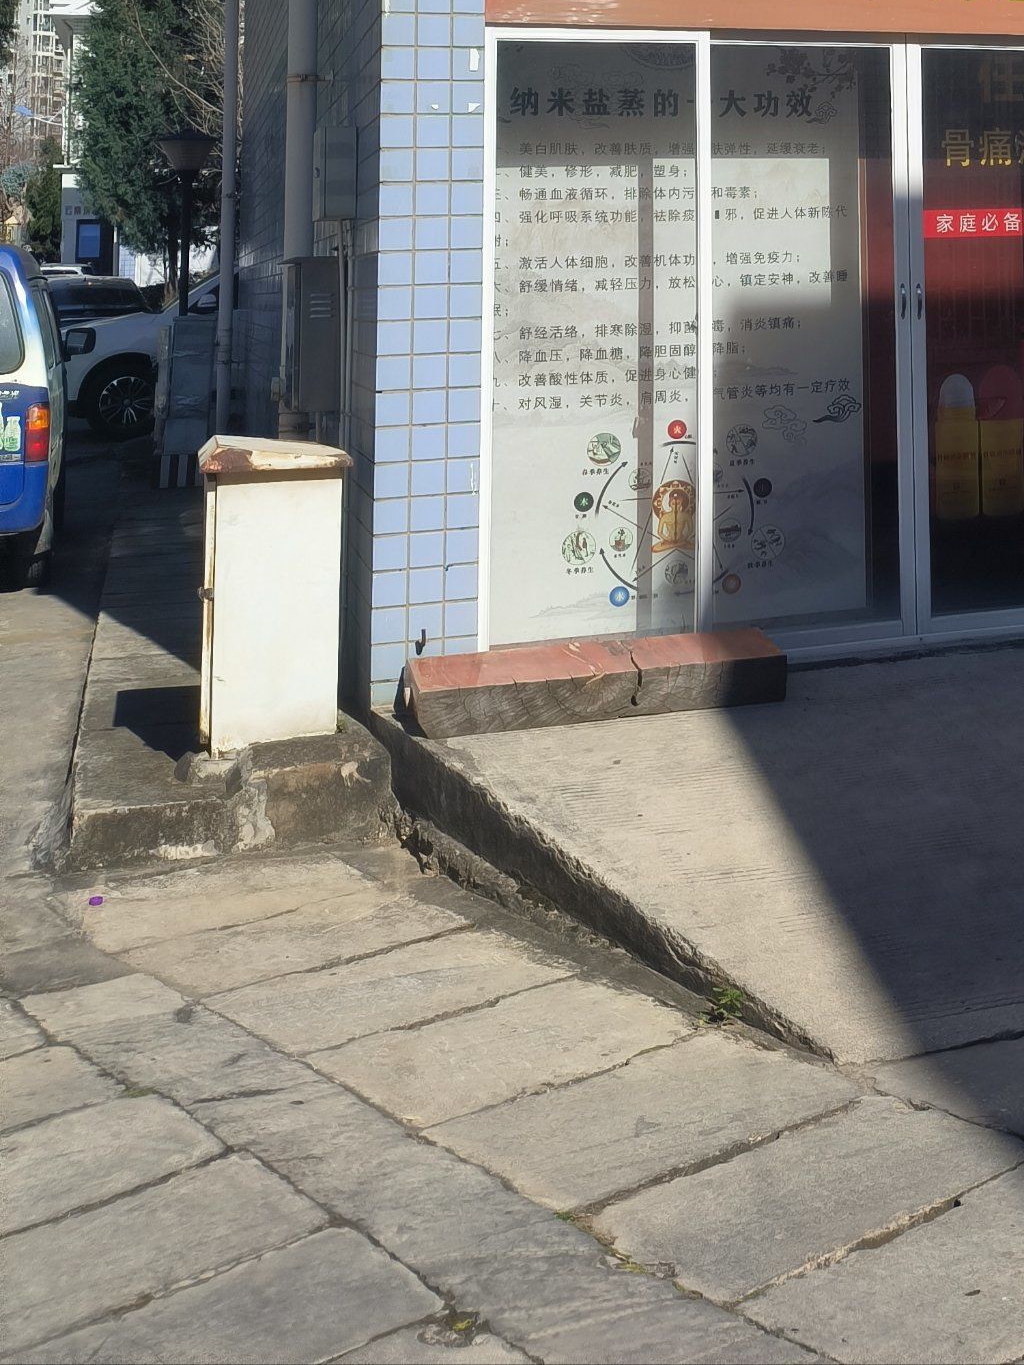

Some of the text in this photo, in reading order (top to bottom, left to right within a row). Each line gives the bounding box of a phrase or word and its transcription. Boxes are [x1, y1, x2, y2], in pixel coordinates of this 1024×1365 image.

[497, 141, 826, 156] 、美白肌肤，改善肤质，增强肤弹性，延缓衰老；
[495, 186, 758, 201] 三、畅通血液循环，排除体内污和毒素；
[494, 251, 800, 269] 五、激活人体细胞，改善机体功，增强免疫力；
[494, 269, 848, 294] 六、舒缓情绪，减轻压力，放松心，镇定安神，改善睡
[494, 316, 800, 340] 七、舒经活络，排寒除湿，抑菌毒，消炎镇痛；
[493, 366, 717, 388] 九、改善酸性体质，促进身心健；
[493, 378, 850, 411] 十、对风湿，关节炎，肩周炎，气管炎等均有一定疗效
